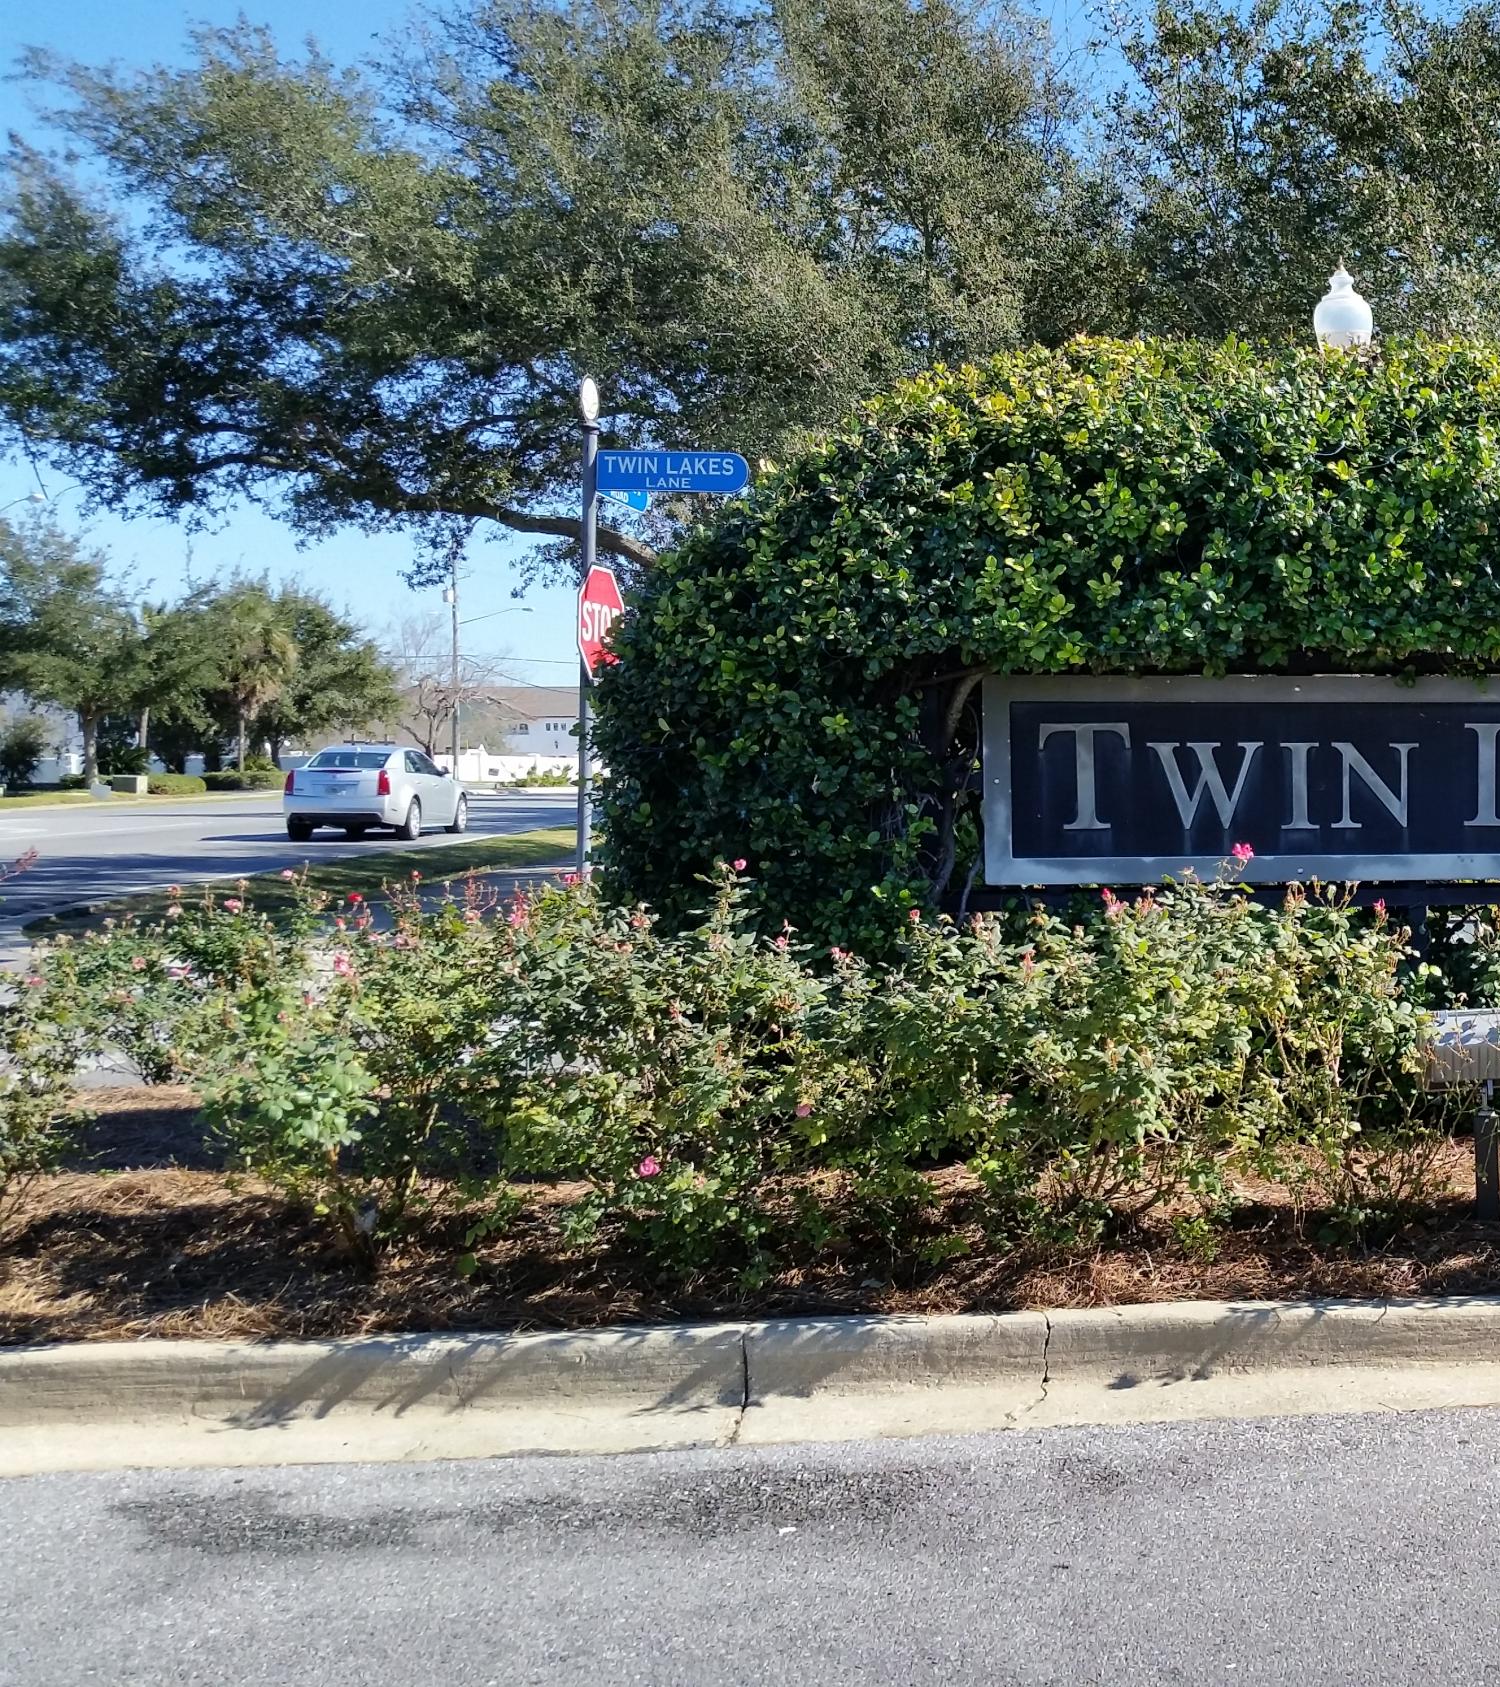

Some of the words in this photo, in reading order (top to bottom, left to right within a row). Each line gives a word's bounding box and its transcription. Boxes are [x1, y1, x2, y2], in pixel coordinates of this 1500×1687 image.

[604, 455, 658, 474] TWIN
[666, 457, 734, 476] LAKES
[646, 477, 691, 489] LANE
[582, 600, 621, 643] STO
[1038, 722, 1420, 830] TWIN
